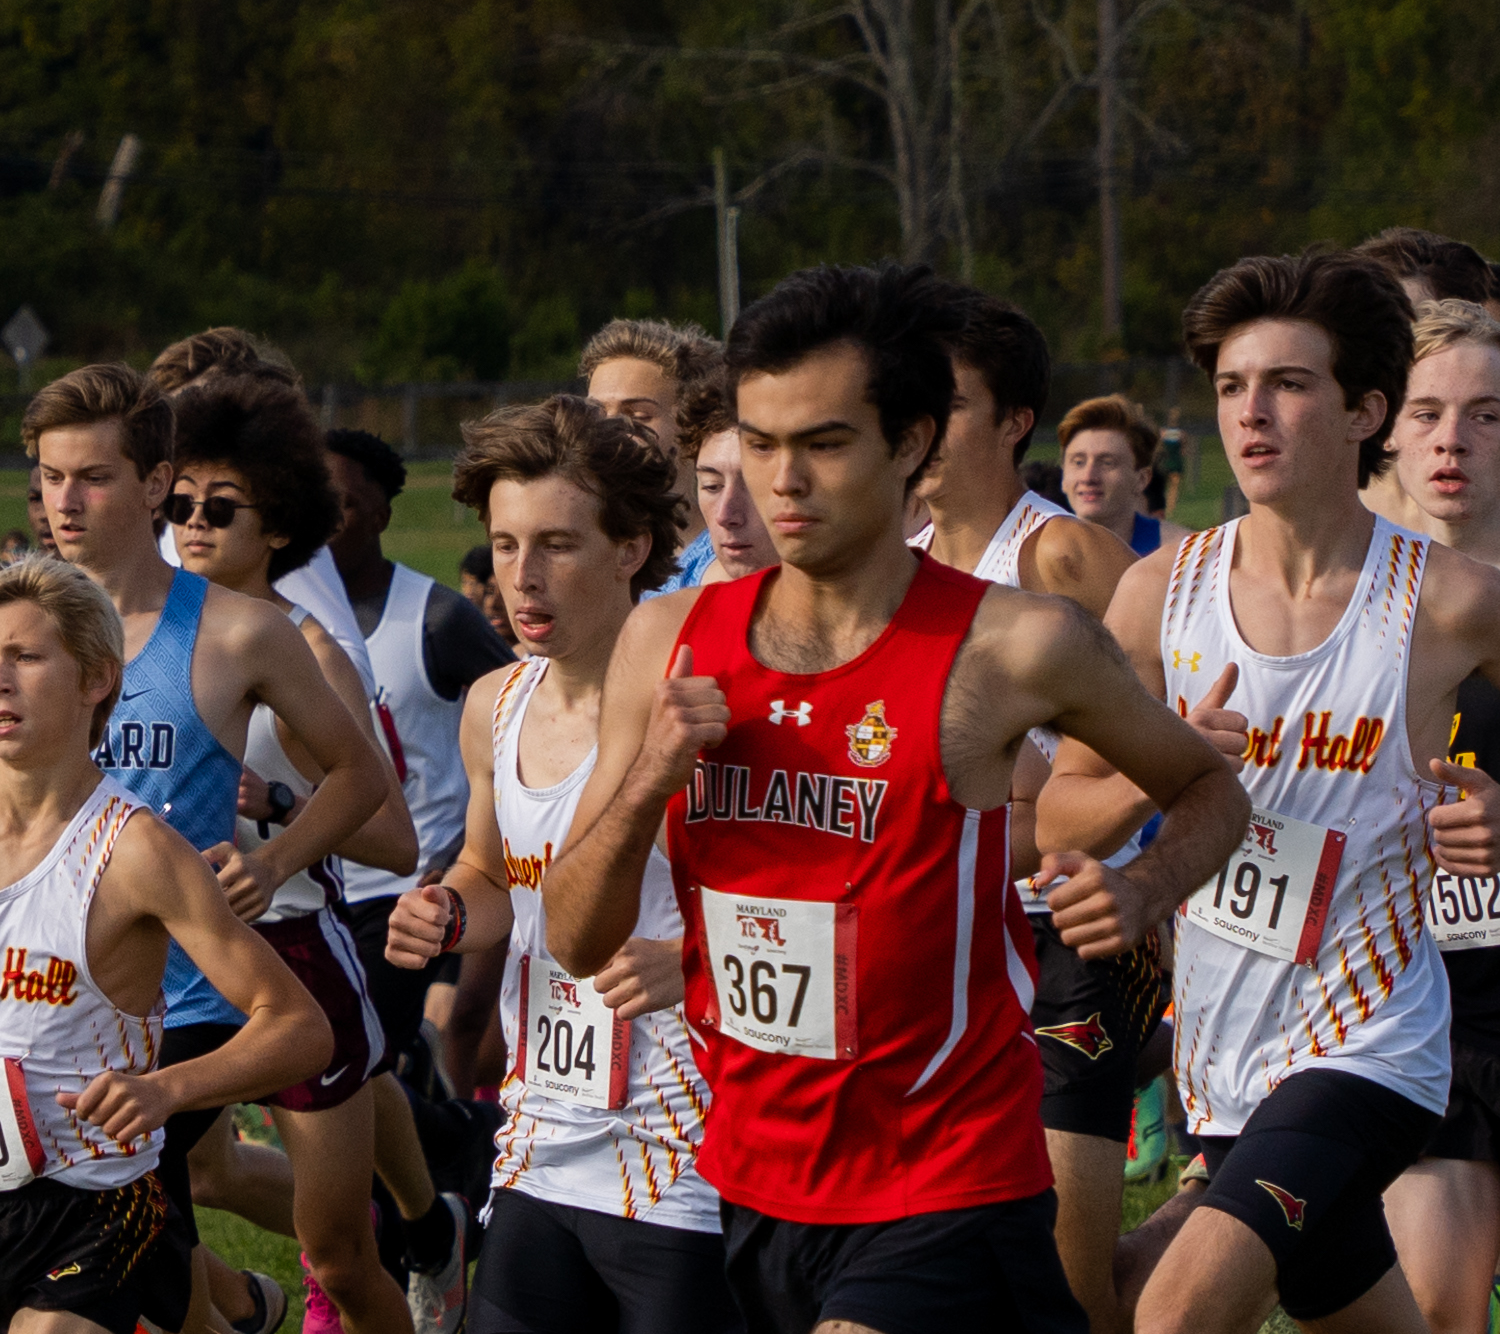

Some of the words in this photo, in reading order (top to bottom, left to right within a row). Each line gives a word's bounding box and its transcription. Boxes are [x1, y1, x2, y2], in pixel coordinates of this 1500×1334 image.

[92, 720, 176, 770] ARD
[1298, 710, 1384, 775] Hall
[685, 758, 889, 844] DULANEY
[1252, 813, 1285, 831] RYLAND
[1213, 861, 1290, 930] 191
[735, 903, 787, 918] MARYLAND
[1212, 916, 1261, 943] saucony
[1446, 930, 1487, 942] saucony
[549, 969, 583, 983] MARYL
[723, 954, 812, 1028] 367
[536, 1014, 596, 1081] 204
[743, 1026, 792, 1047] saucony
[544, 1079, 581, 1097] saucony
